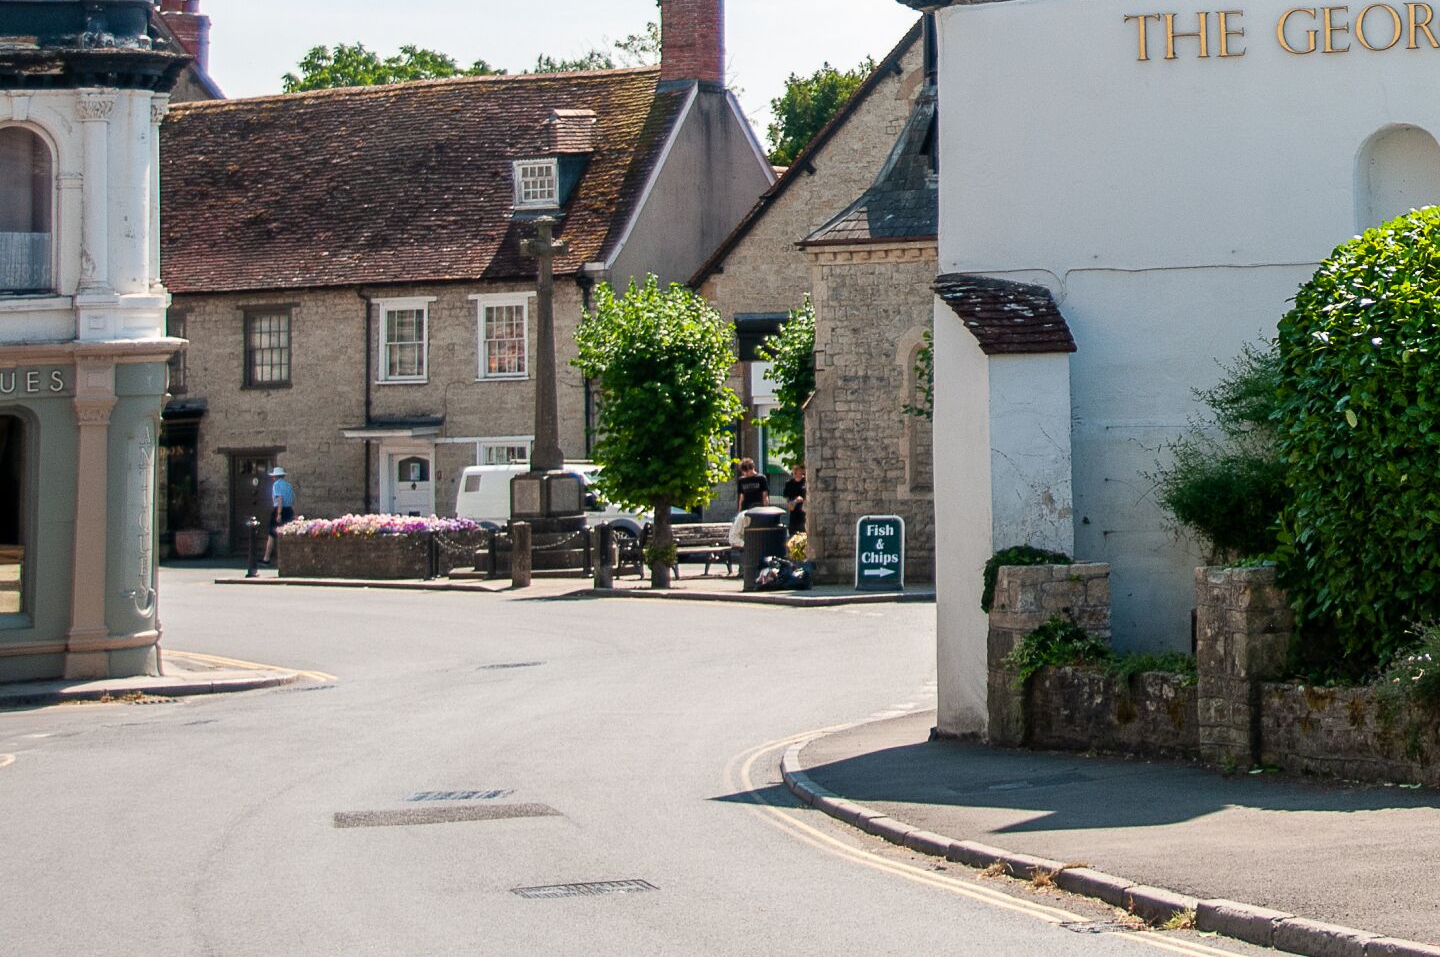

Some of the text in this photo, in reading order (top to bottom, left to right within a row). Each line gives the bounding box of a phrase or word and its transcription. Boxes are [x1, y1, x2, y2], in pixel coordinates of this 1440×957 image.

[1124, 10, 1247, 61] THE
[867, 524, 894, 536] Fish
[876, 538, 885, 550] &
[861, 552, 899, 566] Chips
